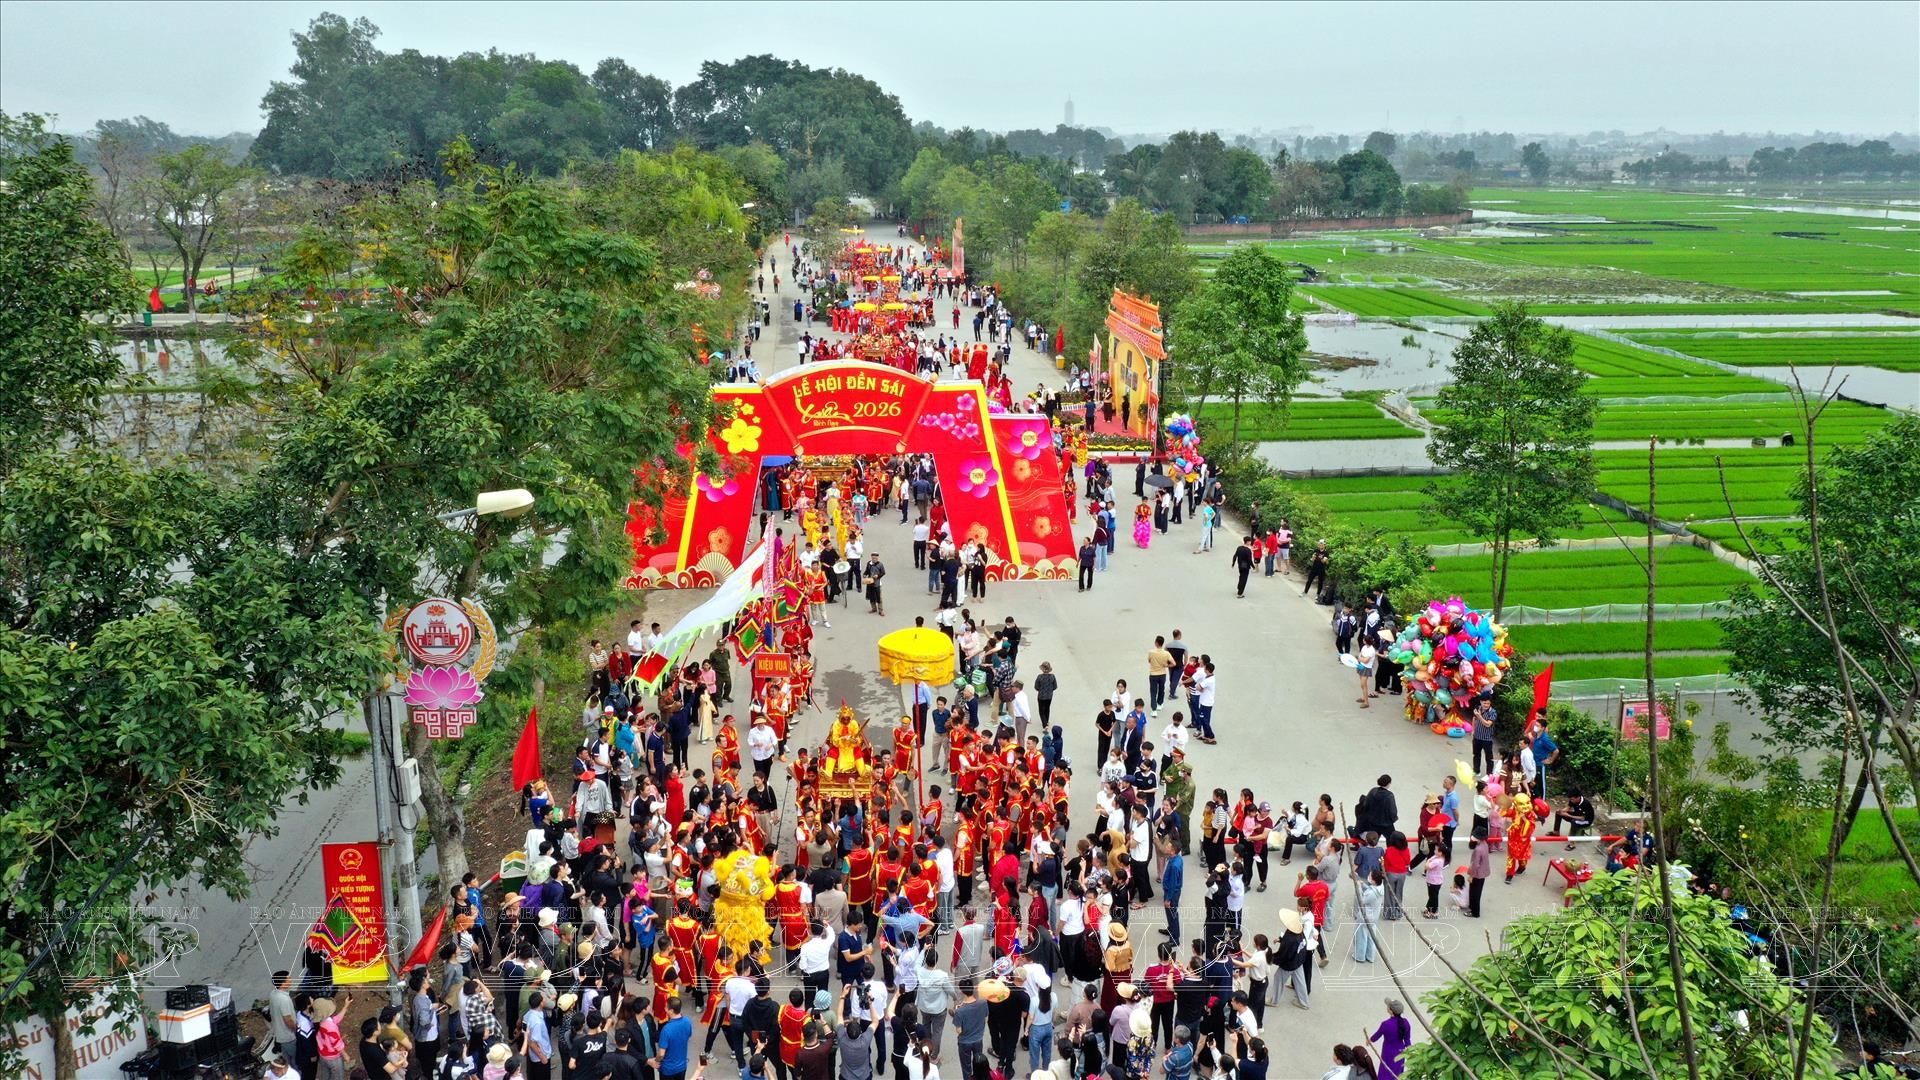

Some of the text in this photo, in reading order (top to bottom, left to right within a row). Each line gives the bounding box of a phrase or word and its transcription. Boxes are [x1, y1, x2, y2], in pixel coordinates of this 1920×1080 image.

[792, 376, 811, 398] LỄ
[815, 374, 842, 393] HỘI
[880, 380, 905, 397] SÁI
[852, 402, 902, 417] 2026
[758, 658, 788, 672] KIỆU VUA
